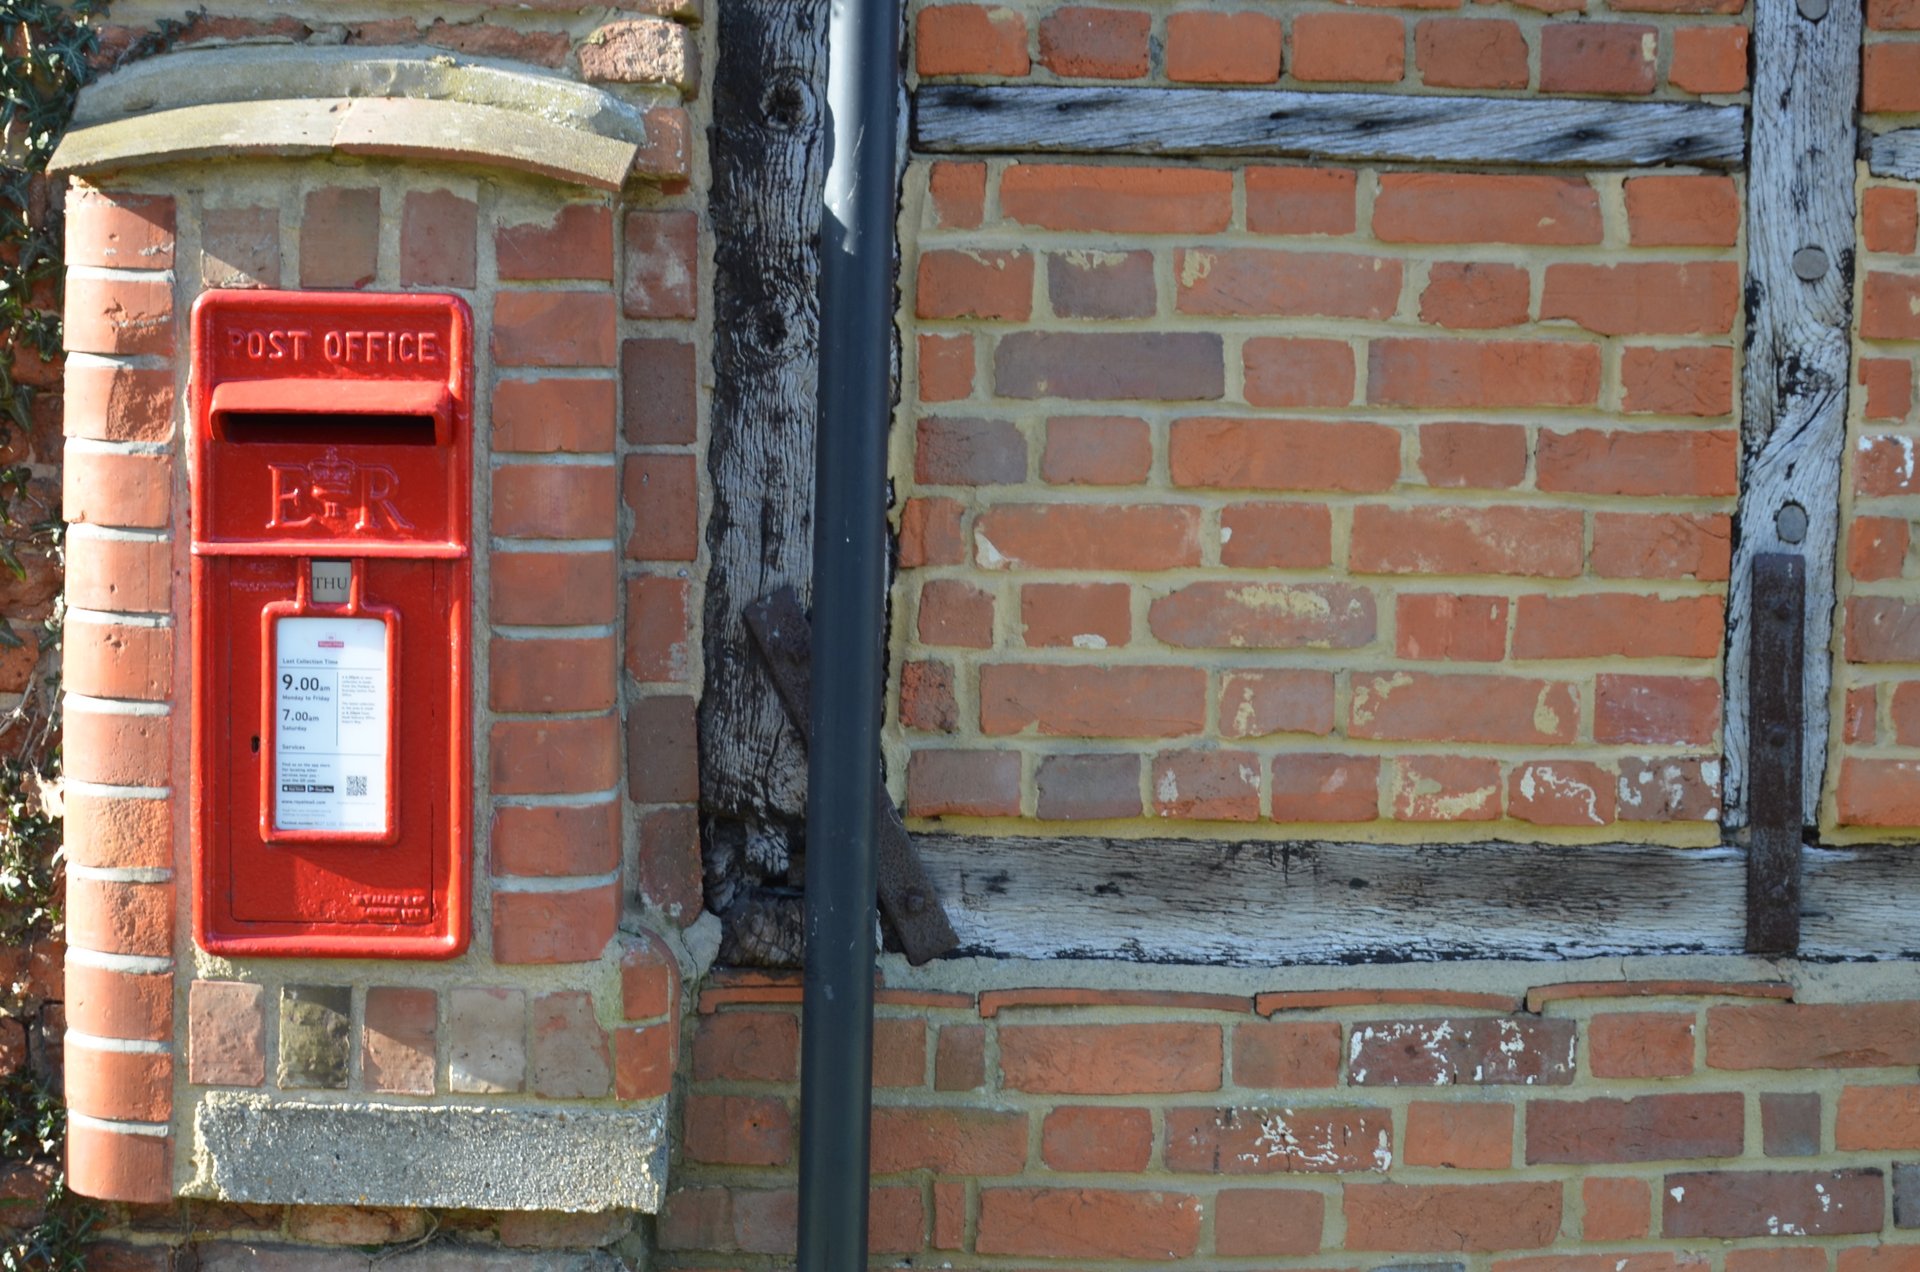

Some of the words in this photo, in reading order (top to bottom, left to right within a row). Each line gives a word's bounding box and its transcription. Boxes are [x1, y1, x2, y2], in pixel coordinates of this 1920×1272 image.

[228, 328, 308, 361] POST
[323, 330, 437, 363] OFFICE
[312, 577, 349, 590] THU
[282, 673, 331, 691] 9.00am
[282, 708, 319, 721] 7.00am
